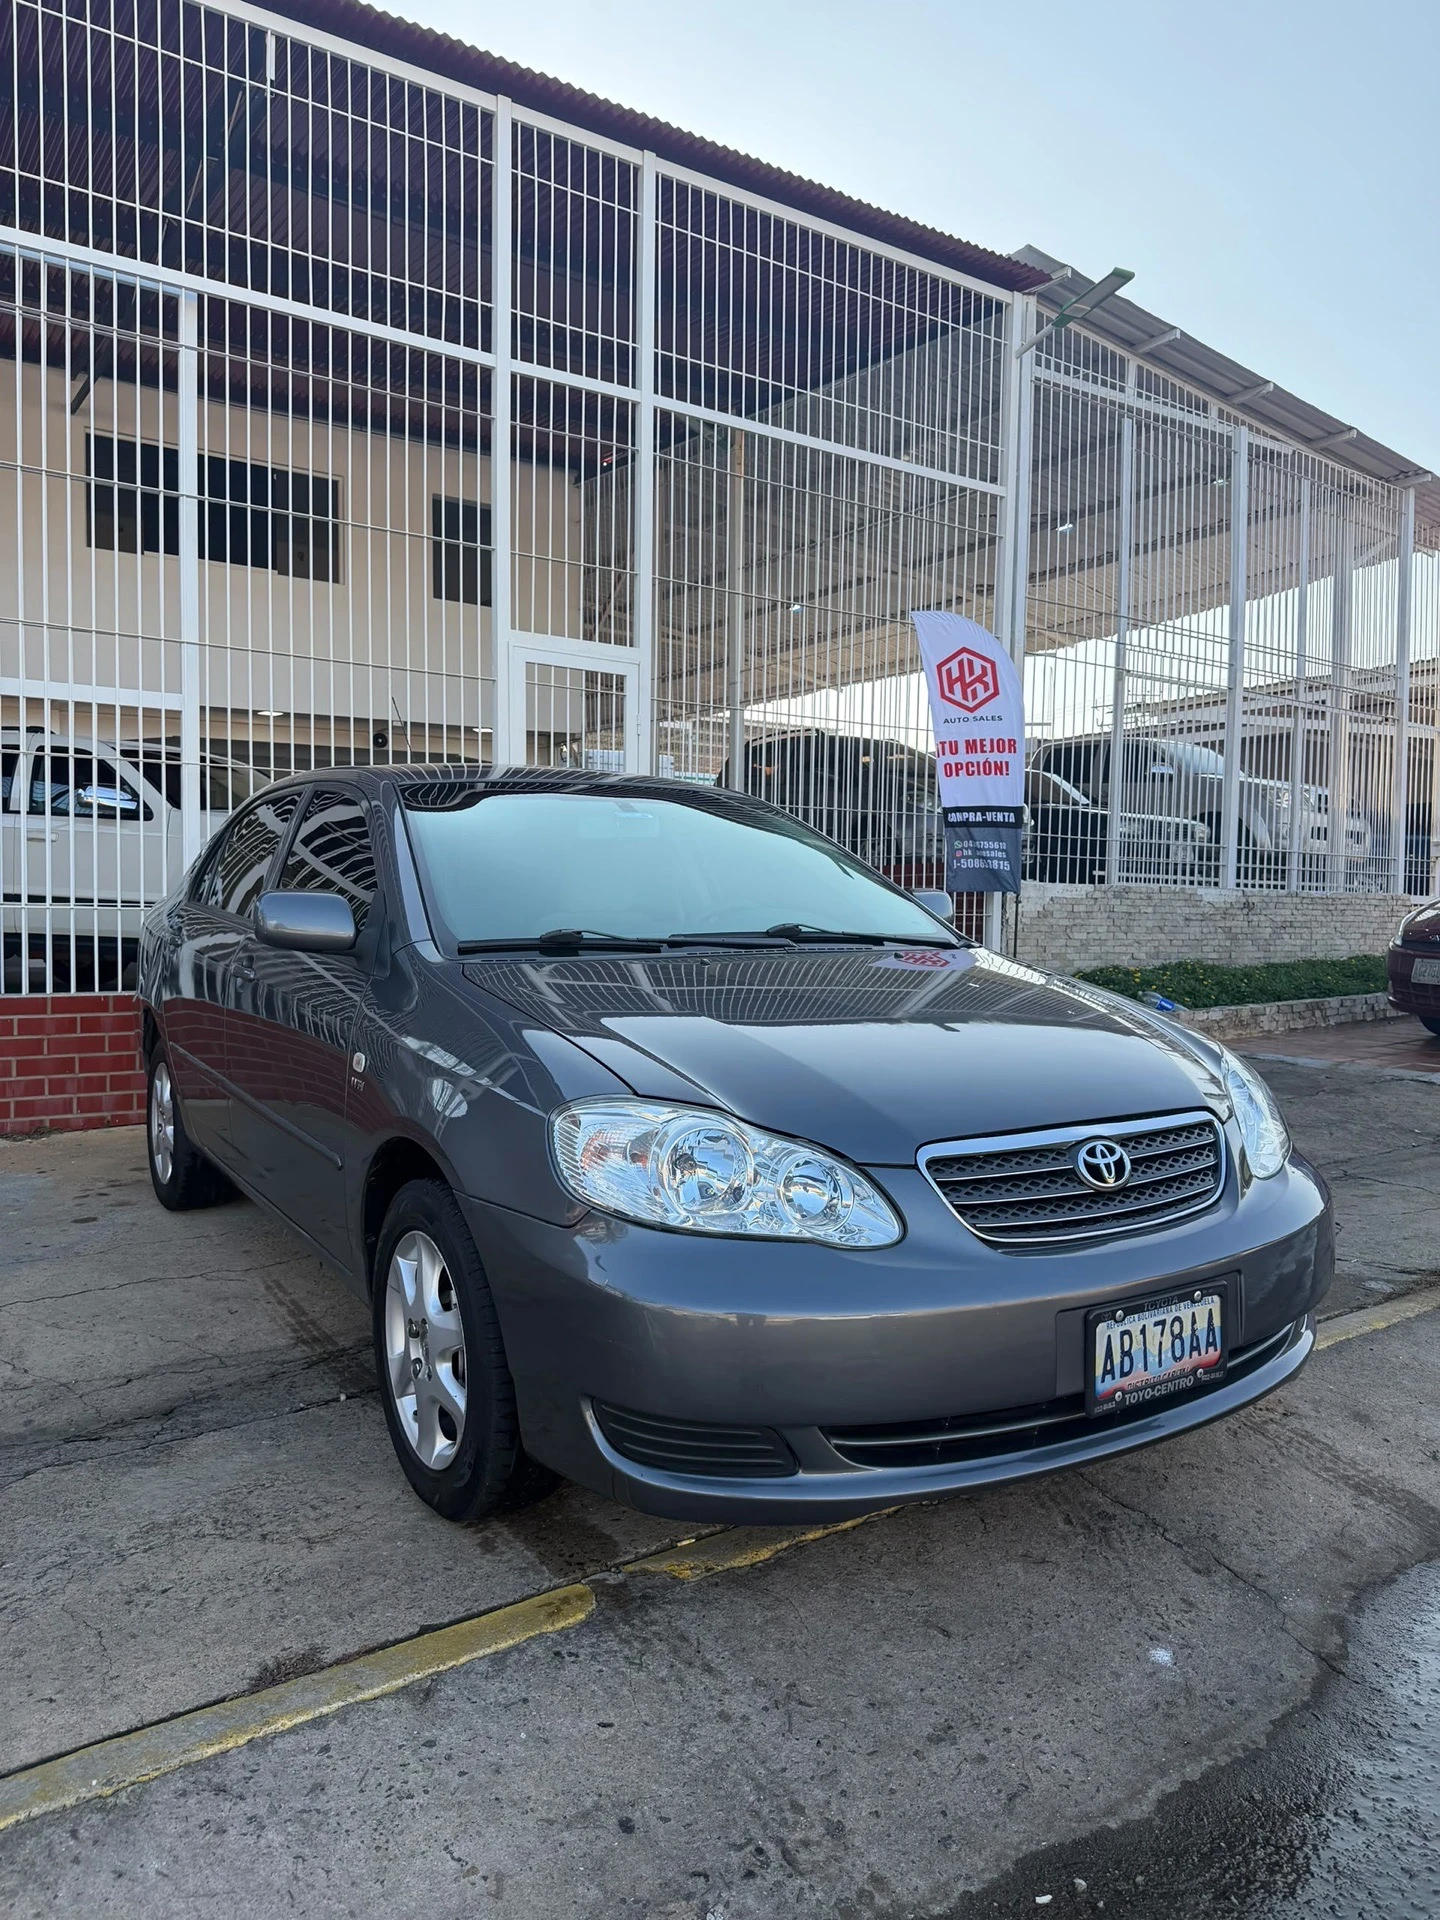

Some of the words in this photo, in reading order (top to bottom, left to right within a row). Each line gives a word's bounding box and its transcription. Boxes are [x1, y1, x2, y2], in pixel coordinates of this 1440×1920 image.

[943, 716, 970, 725] AUTO
[972, 714, 1003, 722] SALES
[965, 738, 1017, 755] MEJOR
[943, 757, 1010, 778] OPCIÓN!
[1143, 1296, 1179, 1311] TOYOTA
[1137, 1306, 1173, 1321] BOLIVARIANA
[1174, 1304, 1182, 1312] DE
[1101, 1308, 1218, 1384] AB178AA
[1124, 1375, 1194, 1406] TOYO-CENTRO
